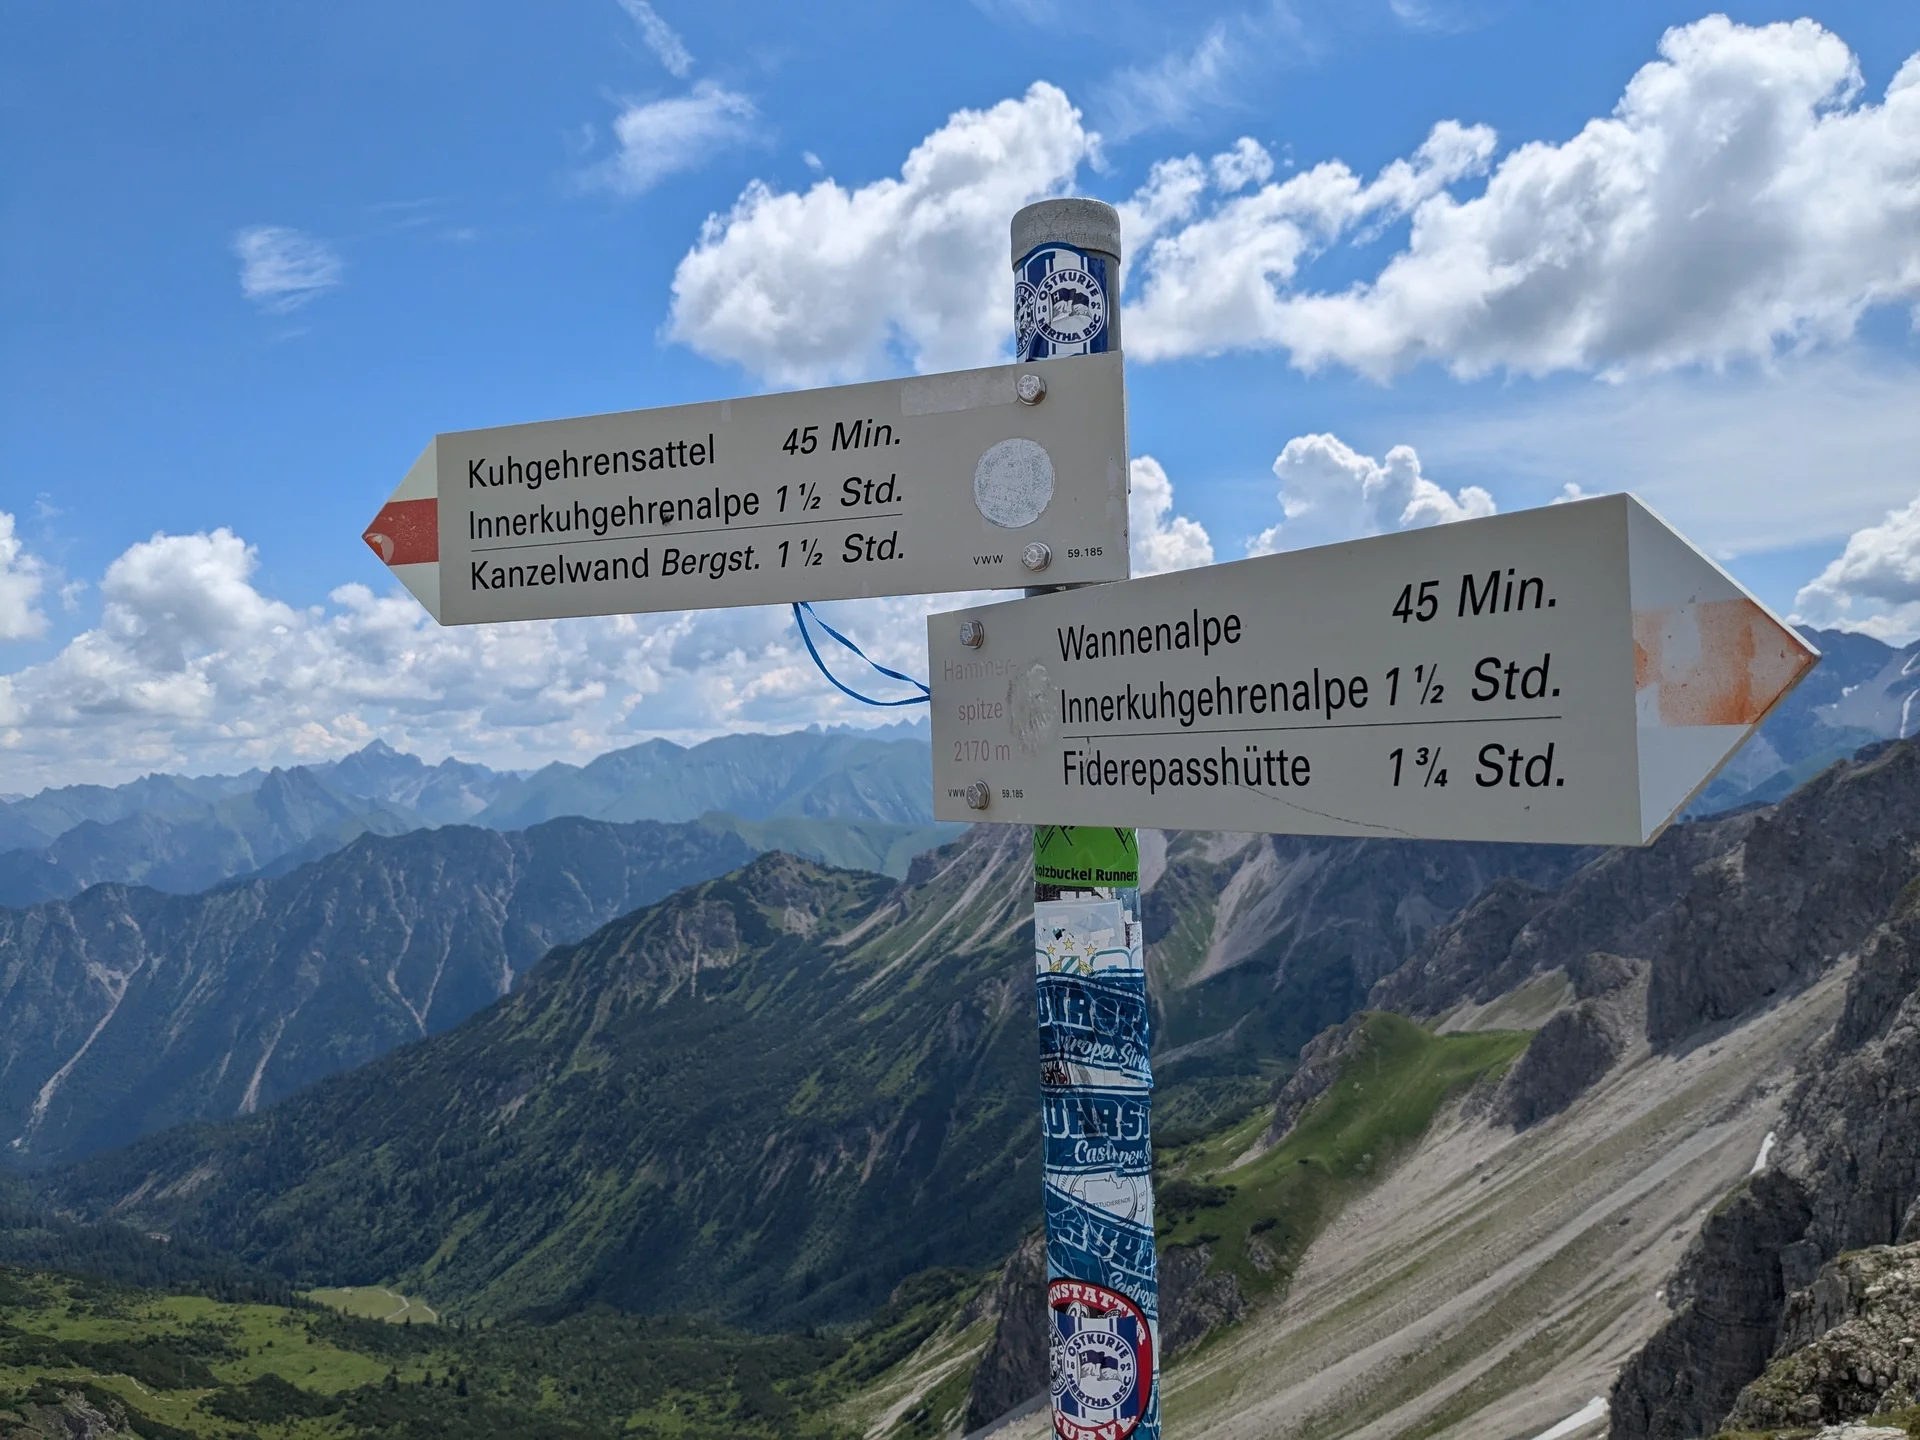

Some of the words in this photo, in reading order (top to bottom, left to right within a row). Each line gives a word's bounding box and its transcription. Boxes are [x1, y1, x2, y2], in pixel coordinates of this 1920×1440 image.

[1040, 272, 1099, 300] OSTKURVE
[1037, 305, 1047, 314] 18
[1090, 301, 1101, 310] 92
[1038, 317, 1081, 341] HERTHA
[1083, 314, 1101, 336] BSC
[468, 433, 715, 489] Kuhgehrensattel
[782, 425, 819, 456] 45
[831, 418, 902, 452] Min.
[469, 487, 760, 540] Innerkuhgehrenalpe
[840, 473, 903, 508] Std.
[471, 547, 649, 591] Kanzelwand
[661, 546, 760, 580] Bergst.
[842, 530, 904, 564] Std.
[972, 554, 1004, 566] VWW
[1067, 546, 1103, 559] 59.185
[1057, 608, 1242, 662] Wannenalpe
[1391, 579, 1440, 624] 45
[1457, 567, 1557, 618] Min.
[1061, 667, 1369, 728] Innerkuhgehrenalpe
[1471, 652, 1561, 702] Std.
[958, 698, 1003, 726] spitze
[953, 740, 991, 763] 2170
[995, 743, 1011, 761] m
[1063, 743, 1311, 795] Fiderepasshütte
[1475, 742, 1565, 788] Std.
[1001, 788, 1024, 799] 59.185
[1095, 868, 1138, 882] Runners
[1068, 1333, 1130, 1359] OSTKURVE
[1066, 1360, 1075, 1370] 18
[1120, 1362, 1132, 1372] 92
[1066, 1374, 1111, 1407] HERTHA
[1112, 1375, 1131, 1402] BSC
